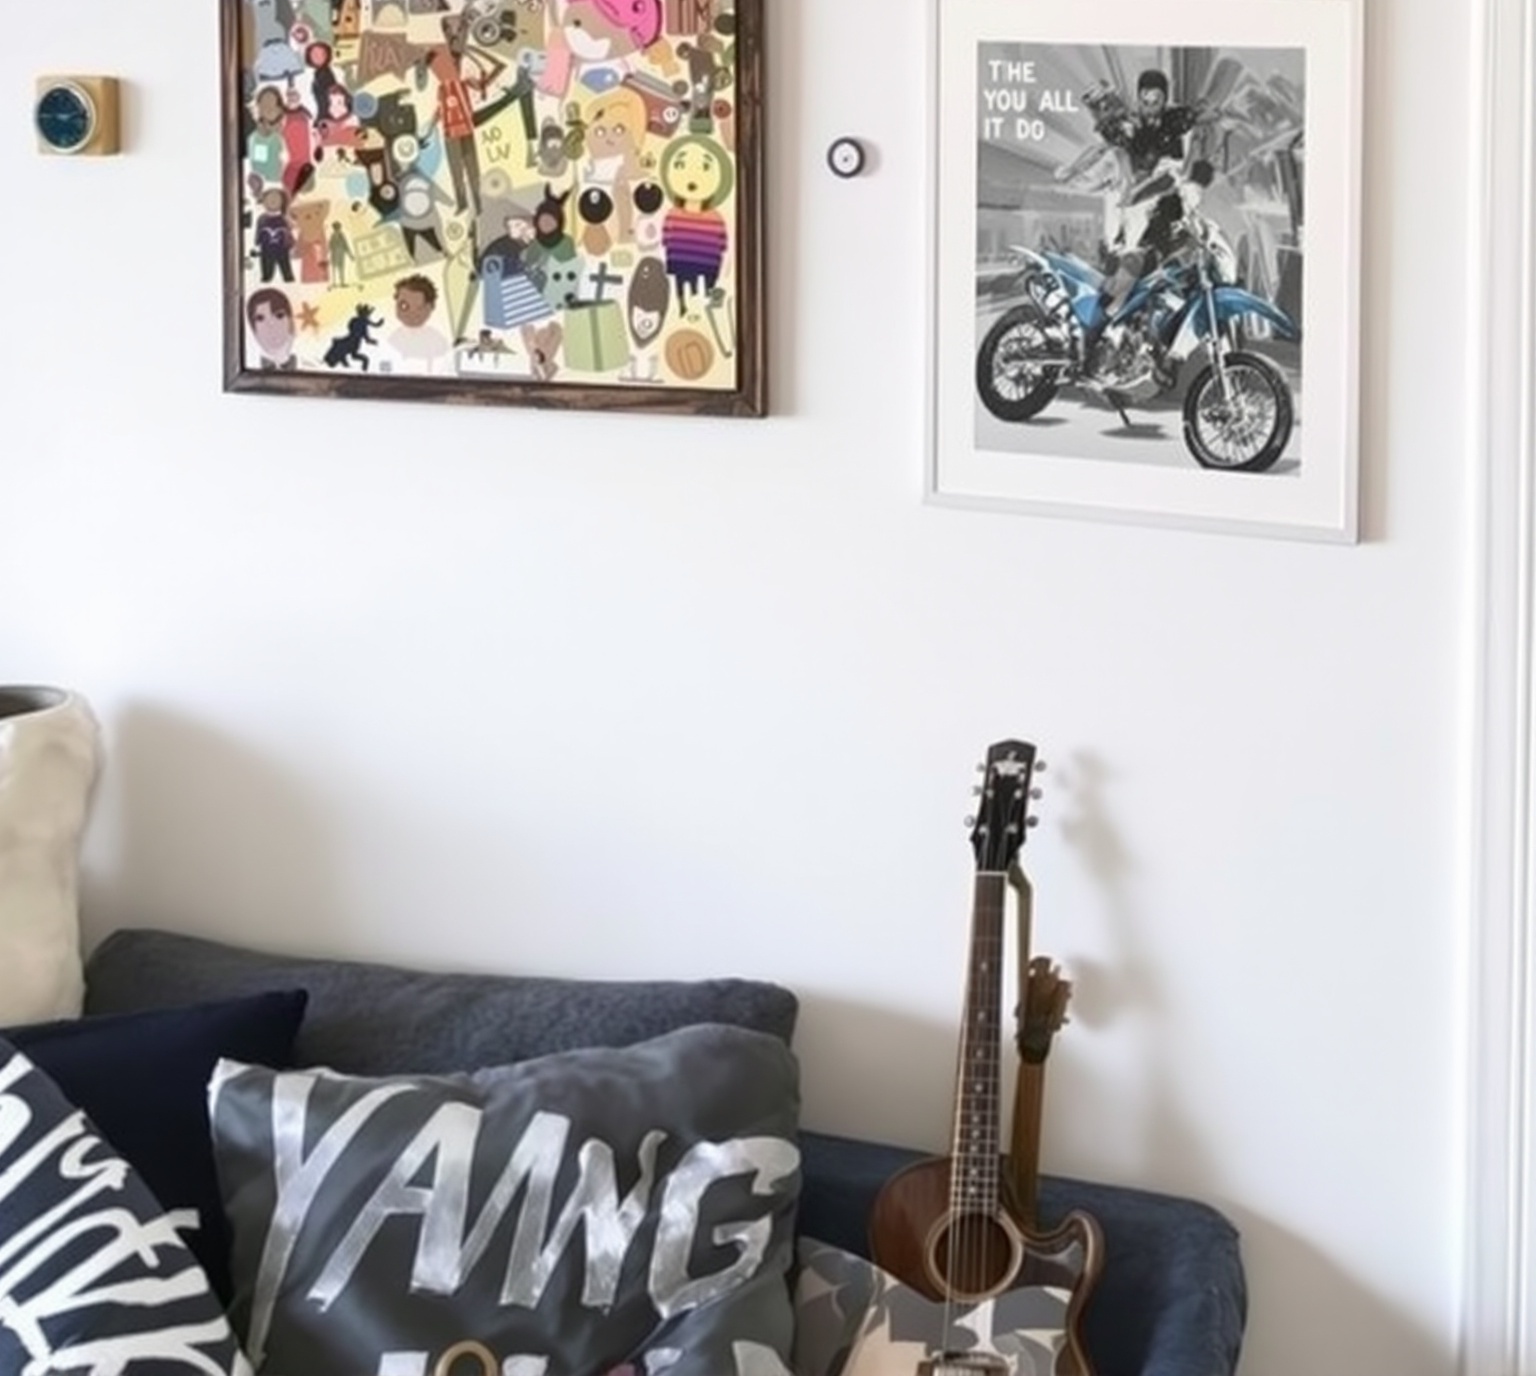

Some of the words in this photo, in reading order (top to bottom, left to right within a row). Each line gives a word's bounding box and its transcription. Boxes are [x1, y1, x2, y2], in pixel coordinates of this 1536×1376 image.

[988, 60, 1036, 83] THE
[983, 89, 1027, 112] YOU
[1038, 89, 1079, 112] ALL
[985, 118, 1003, 140] IT
[1016, 118, 1045, 141] DO
